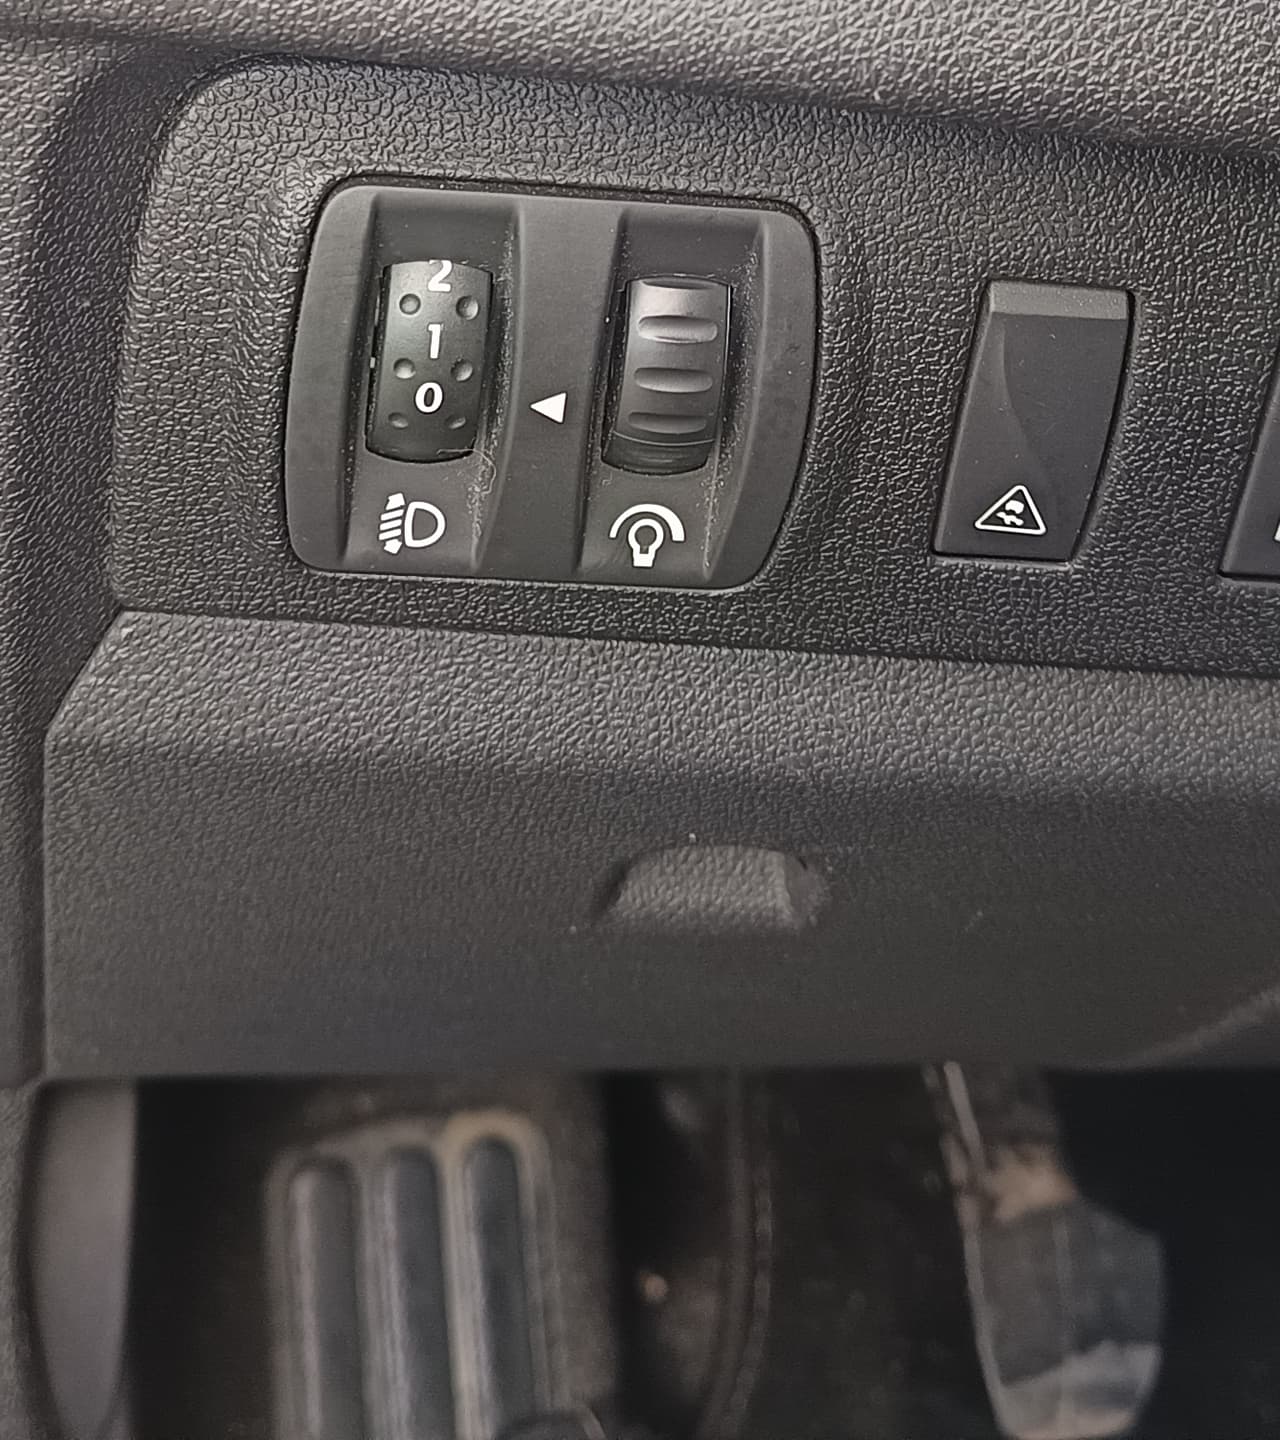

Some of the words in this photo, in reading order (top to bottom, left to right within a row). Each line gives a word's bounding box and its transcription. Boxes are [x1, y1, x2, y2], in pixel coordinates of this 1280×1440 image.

[426, 259, 453, 292] 2
[426, 323, 444, 360] 1
[414, 381, 444, 414] 0
